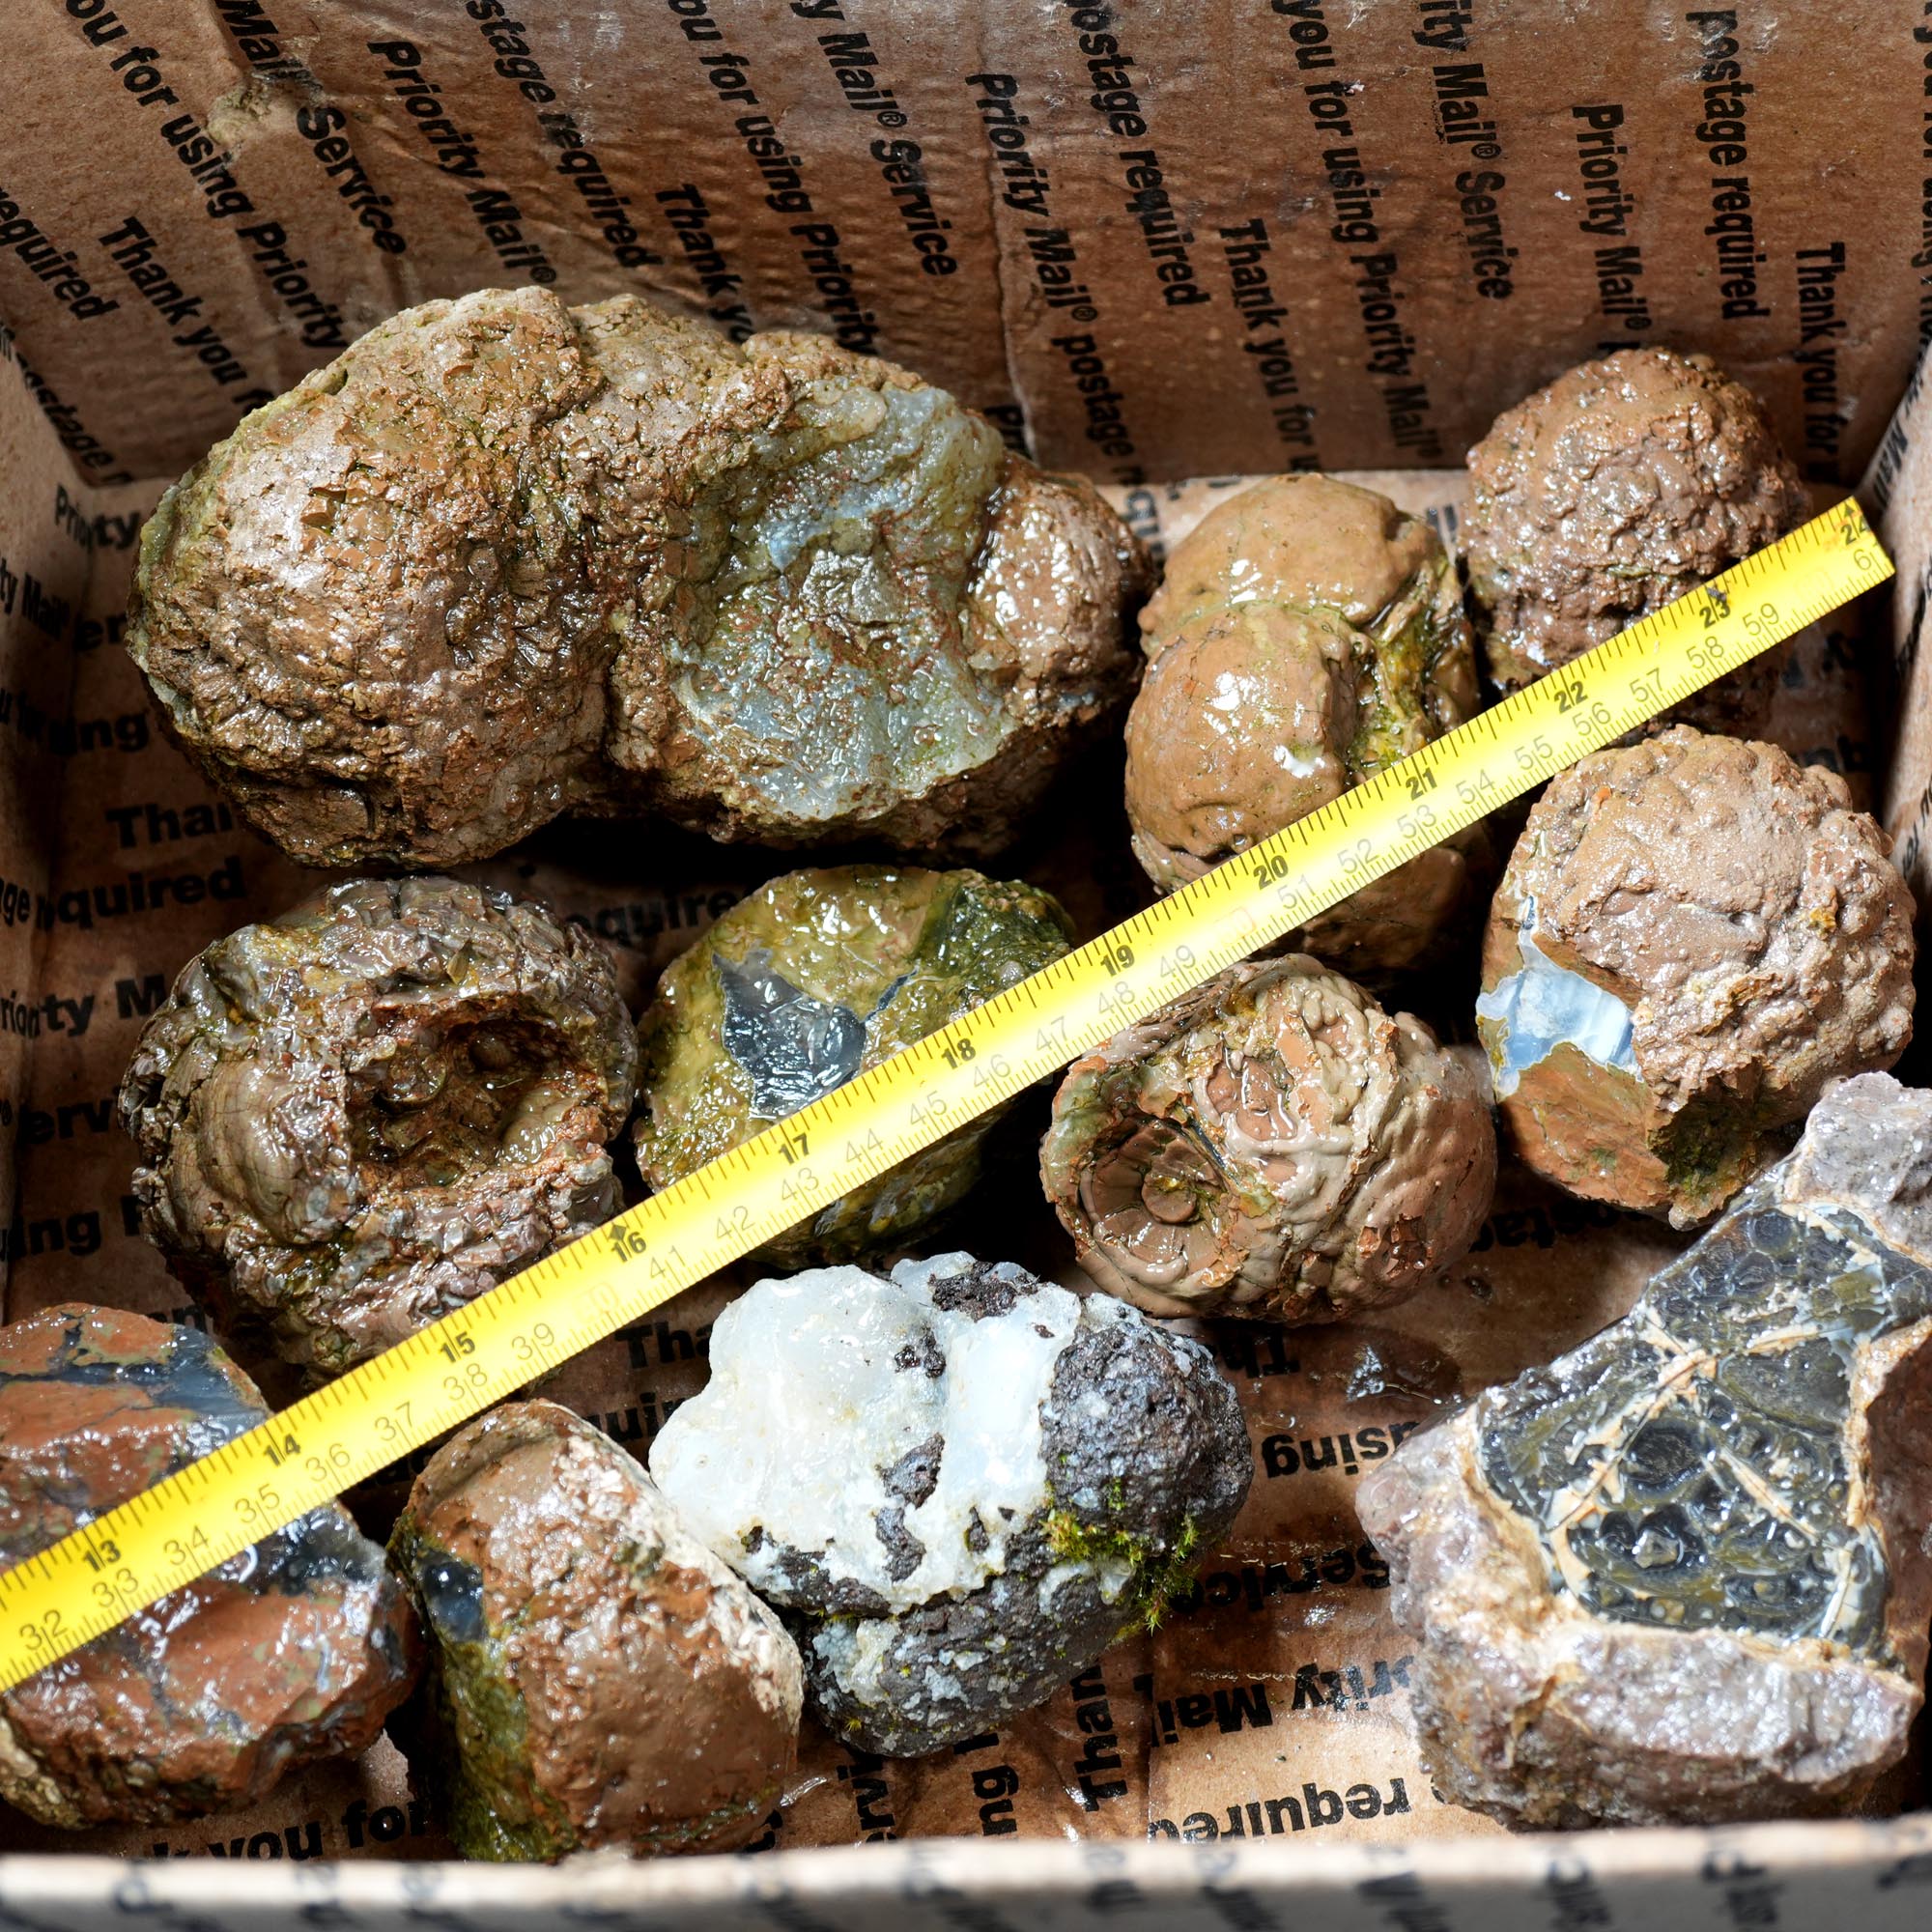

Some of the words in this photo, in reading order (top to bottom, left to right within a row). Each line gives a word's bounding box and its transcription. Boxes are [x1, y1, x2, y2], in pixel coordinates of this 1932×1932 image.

[367, 42, 485, 178] Priority
[466, 0, 556, 103] stage
[537, 113, 665, 269] required
[1065, 0, 1149, 137] ostage
[1119, 150, 1211, 305] required
[1304, 80, 1355, 137] for
[1686, 10, 1754, 166] postage
[66, 0, 128, 46] ou
[109, 46, 180, 106] for
[160, 114, 255, 218] using
[236, 222, 351, 348] Priority
[297, 106, 408, 254] Service
[668, 0, 724, 42] ou
[698, 53, 760, 105] for
[734, 115, 813, 213] using
[789, 223, 881, 355] Priority
[869, 139, 957, 276] Service
[1321, 147, 1381, 243] using
[1455, 170, 1520, 301] Service
[1572, 104, 1634, 237] Priority
[0, 187, 120, 321] equired
[99, 215, 204, 326] Thank
[172, 326, 247, 384] you
[655, 183, 744, 298] Thank
[966, 74, 1051, 217] Priority
[1051, 333, 1135, 457] postage
[1219, 218, 1290, 332] Thank
[1704, 177, 1771, 320] required
[1795, 242, 1847, 345] Thank
[1243, 338, 1299, 398] you
[1350, 252, 1406, 378] Priority
[1792, 346, 1837, 405] you
[1272, 403, 1317, 446] for
[19, 1609, 69, 1651] 32
[93, 1568, 139, 1608] 33
[163, 1524, 209, 1566] 34
[235, 1483, 280, 1523] 35
[305, 1443, 351, 1482] 36
[375, 1402, 413, 1441] 37
[443, 1363, 488, 1401] 38
[511, 1322, 554, 1360] 39
[649, 1244, 687, 1279] 41
[716, 1206, 755, 1240] 42
[781, 1167, 819, 1202] 43
[845, 1128, 884, 1163] 44
[909, 1090, 948, 1127] 45
[973, 1053, 1011, 1090] 46
[1036, 1015, 1069, 1052] 47
[1097, 980, 1136, 1015] 48
[1159, 944, 1197, 981] 49
[1277, 873, 1316, 909] 51
[1336, 838, 1379, 874] 52
[1397, 804, 1437, 839] 53
[1455, 769, 1495, 806] 54
[1514, 734, 1553, 771] 55
[1572, 701, 1612, 737] 56
[1629, 668, 1666, 703] 57
[1686, 636, 1724, 669] 58
[1742, 603, 1780, 637] 59
[82, 1539, 122, 1573] 13
[263, 1434, 301, 1466] 14
[440, 1331, 476, 1363] 15
[611, 1232, 647, 1263] 16
[778, 1132, 810, 1164] 17
[941, 1038, 977, 1070] 18
[1101, 945, 1135, 977] 19
[1254, 855, 1289, 890] 20
[1406, 767, 1438, 801] 21
[1553, 680, 1588, 714] 22
[1699, 595, 1731, 630] 23
[1069, 1665, 1128, 1812] Than
